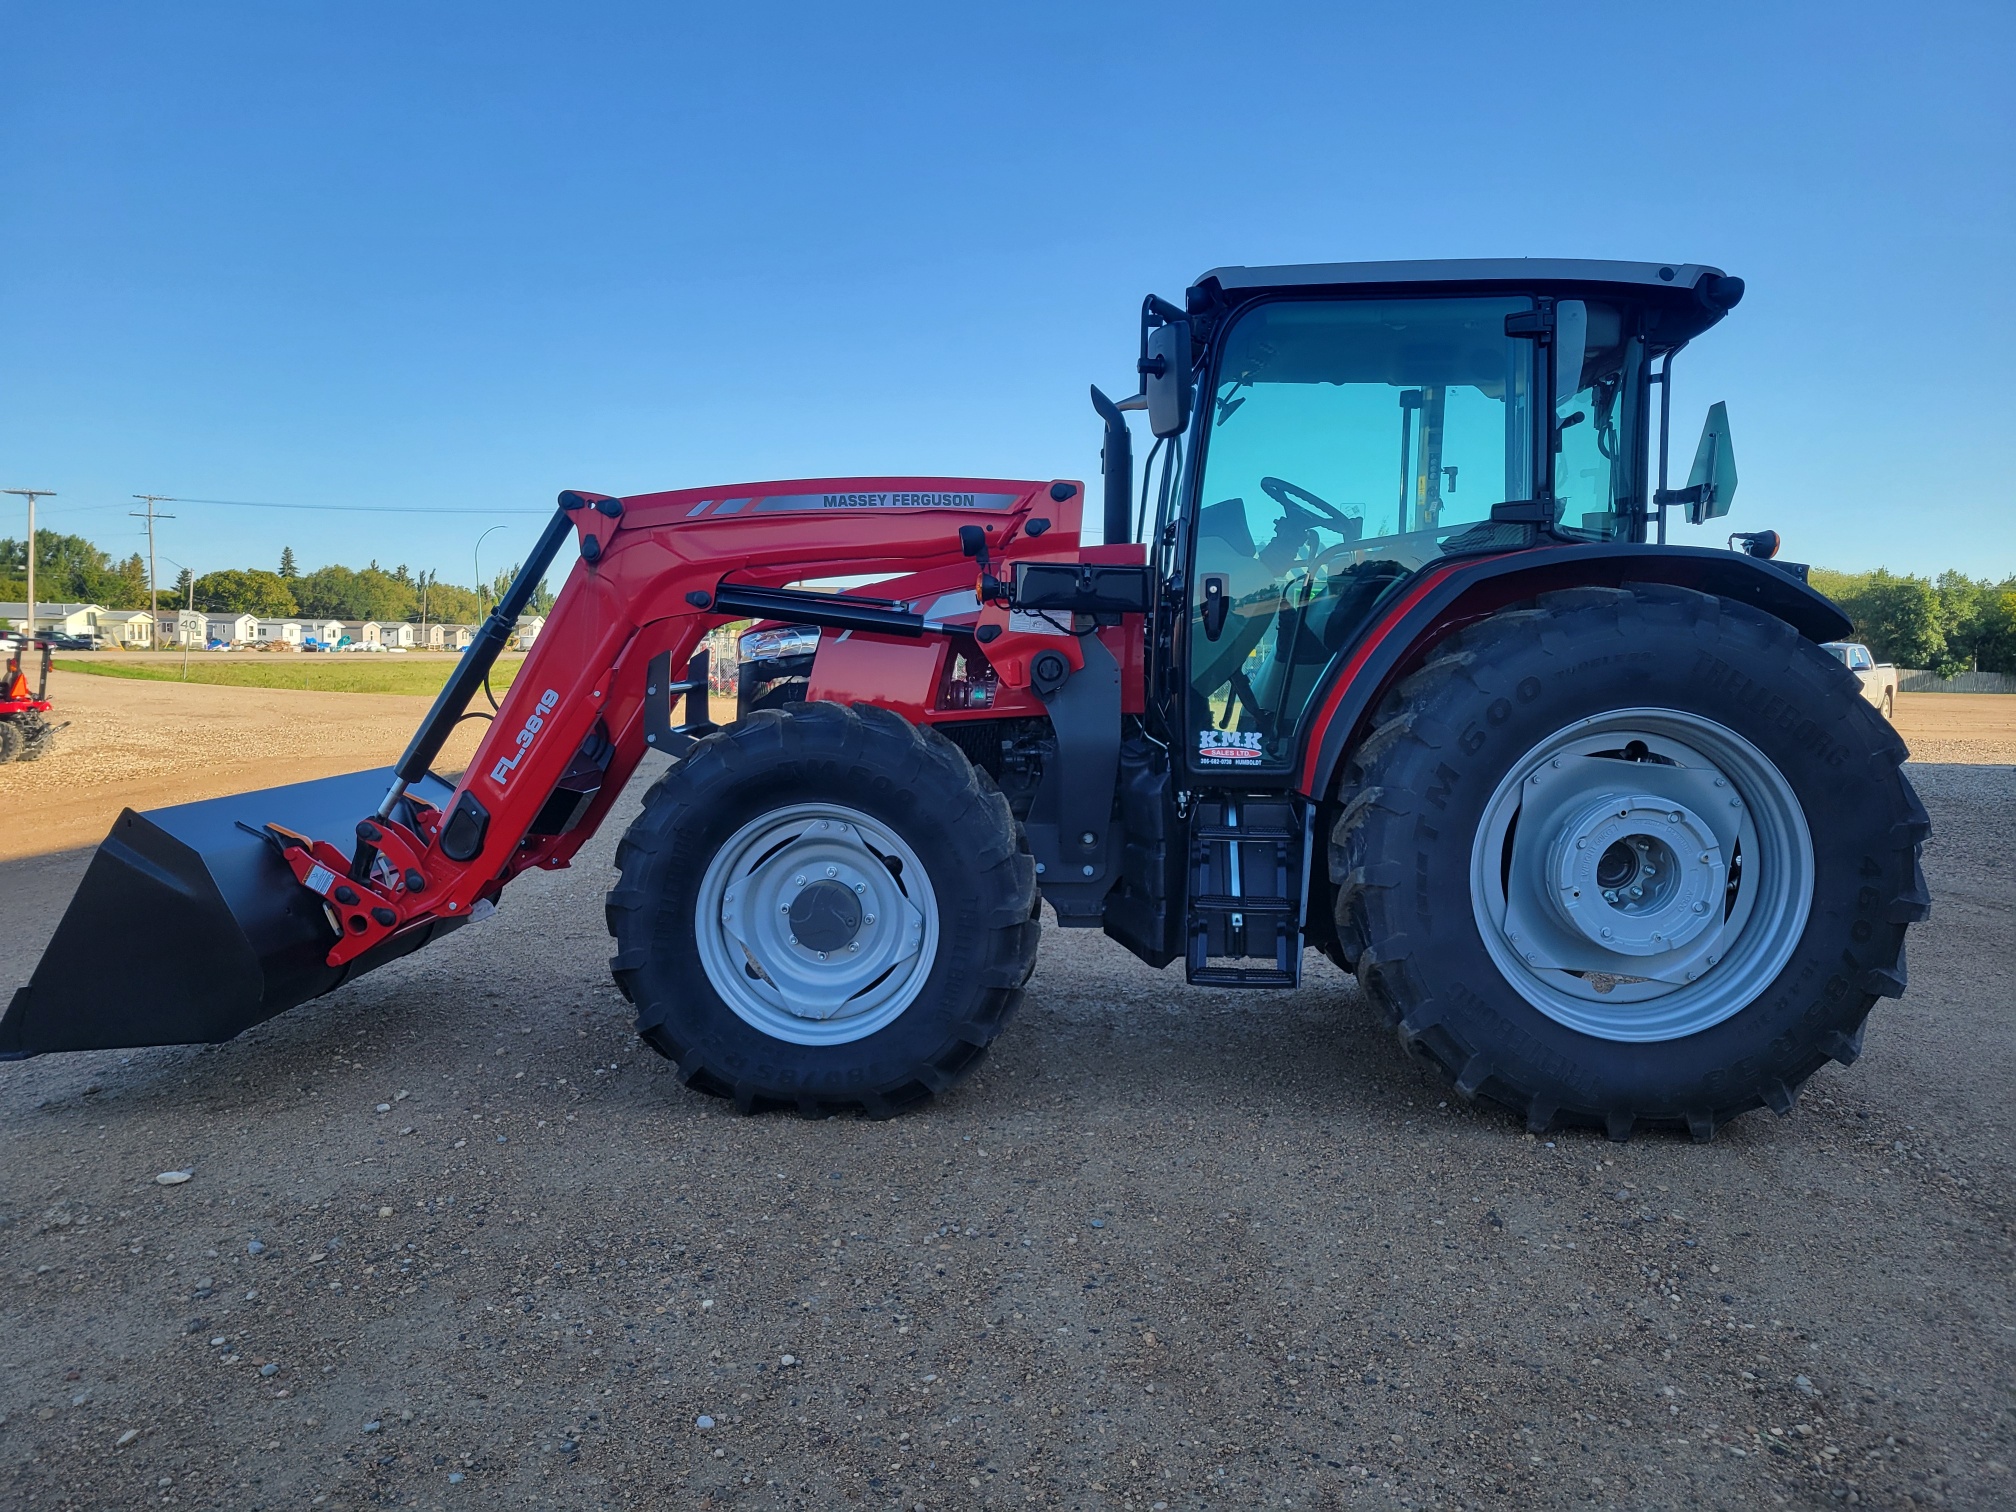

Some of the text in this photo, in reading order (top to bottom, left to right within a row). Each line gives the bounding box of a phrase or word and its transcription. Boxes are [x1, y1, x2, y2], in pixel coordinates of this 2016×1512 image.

[823, 493, 975, 508] MASSEY FERGUSON
[180, 620, 197, 630] 40
[490, 688, 560, 785] FL.3819
[1211, 749, 1235, 757] SALES
[1413, 675, 1542, 842] TM 600
[1678, 890, 1694, 913] AGCO
